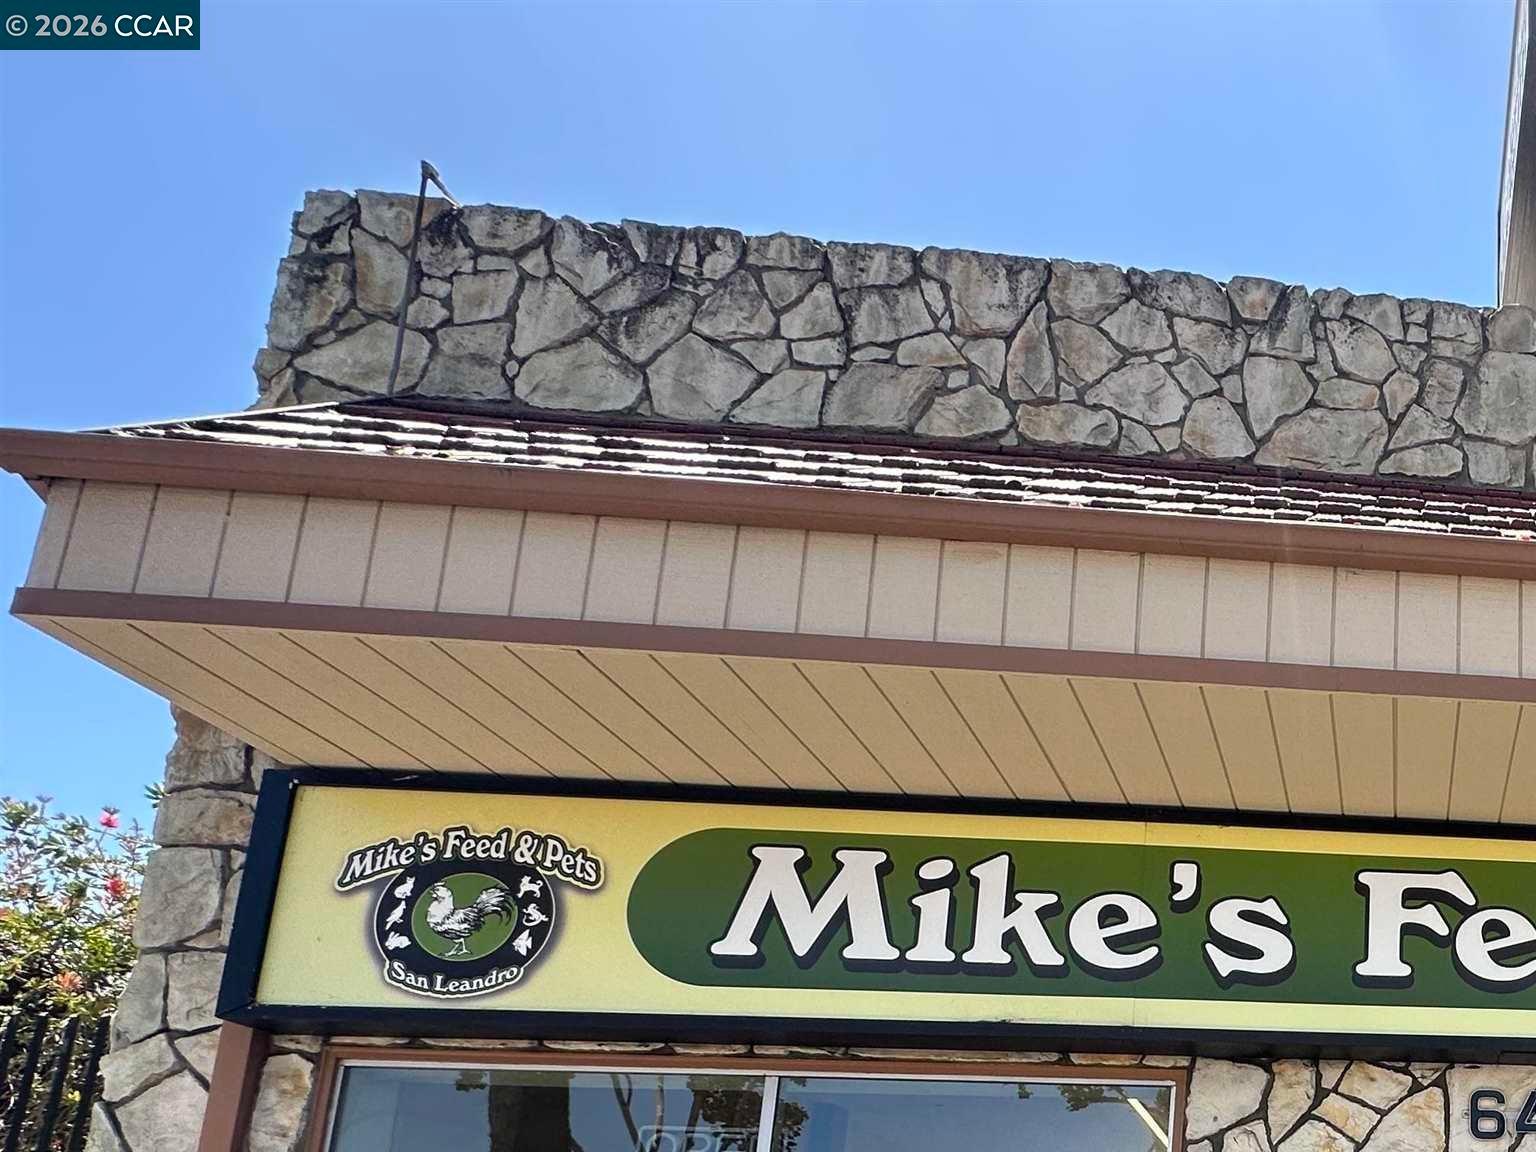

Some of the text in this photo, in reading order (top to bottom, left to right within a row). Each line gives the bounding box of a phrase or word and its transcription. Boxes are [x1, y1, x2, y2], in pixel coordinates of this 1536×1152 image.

[341, 829, 598, 884] Mike's Feed & Pets
[708, 845, 1296, 981] Mike's
[390, 960, 519, 993] San Leandro
